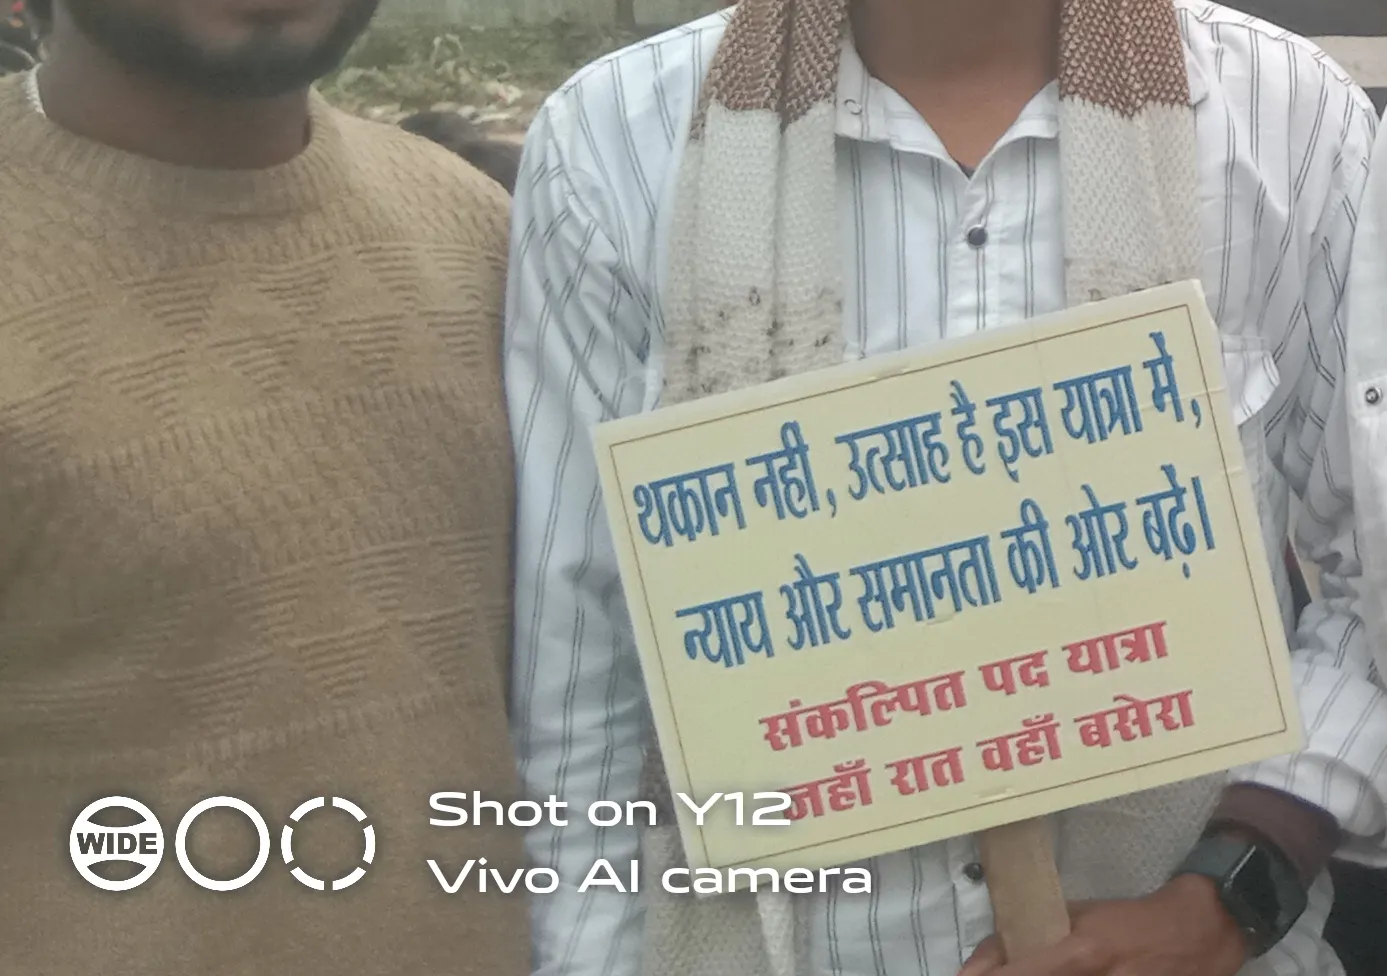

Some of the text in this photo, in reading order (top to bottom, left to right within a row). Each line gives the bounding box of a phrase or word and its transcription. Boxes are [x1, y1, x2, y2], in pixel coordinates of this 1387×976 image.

[633, 462, 747, 548] थकान
[834, 412, 951, 501] उत्साह
[950, 379, 986, 475] है
[985, 386, 1054, 483] इस
[1053, 364, 1143, 444] यात्रा
[675, 590, 775, 669] न्याय
[779, 552, 852, 651] और
[848, 535, 1002, 633] समानता
[1000, 498, 1061, 594] की
[1065, 483, 1138, 581] ओर
[759, 619, 1168, 752] संकल्पित पद यात्रा
[885, 745, 965, 796] रात
[976, 712, 1062, 771] वहाँ
[1073, 689, 1196, 749] बसेरा
